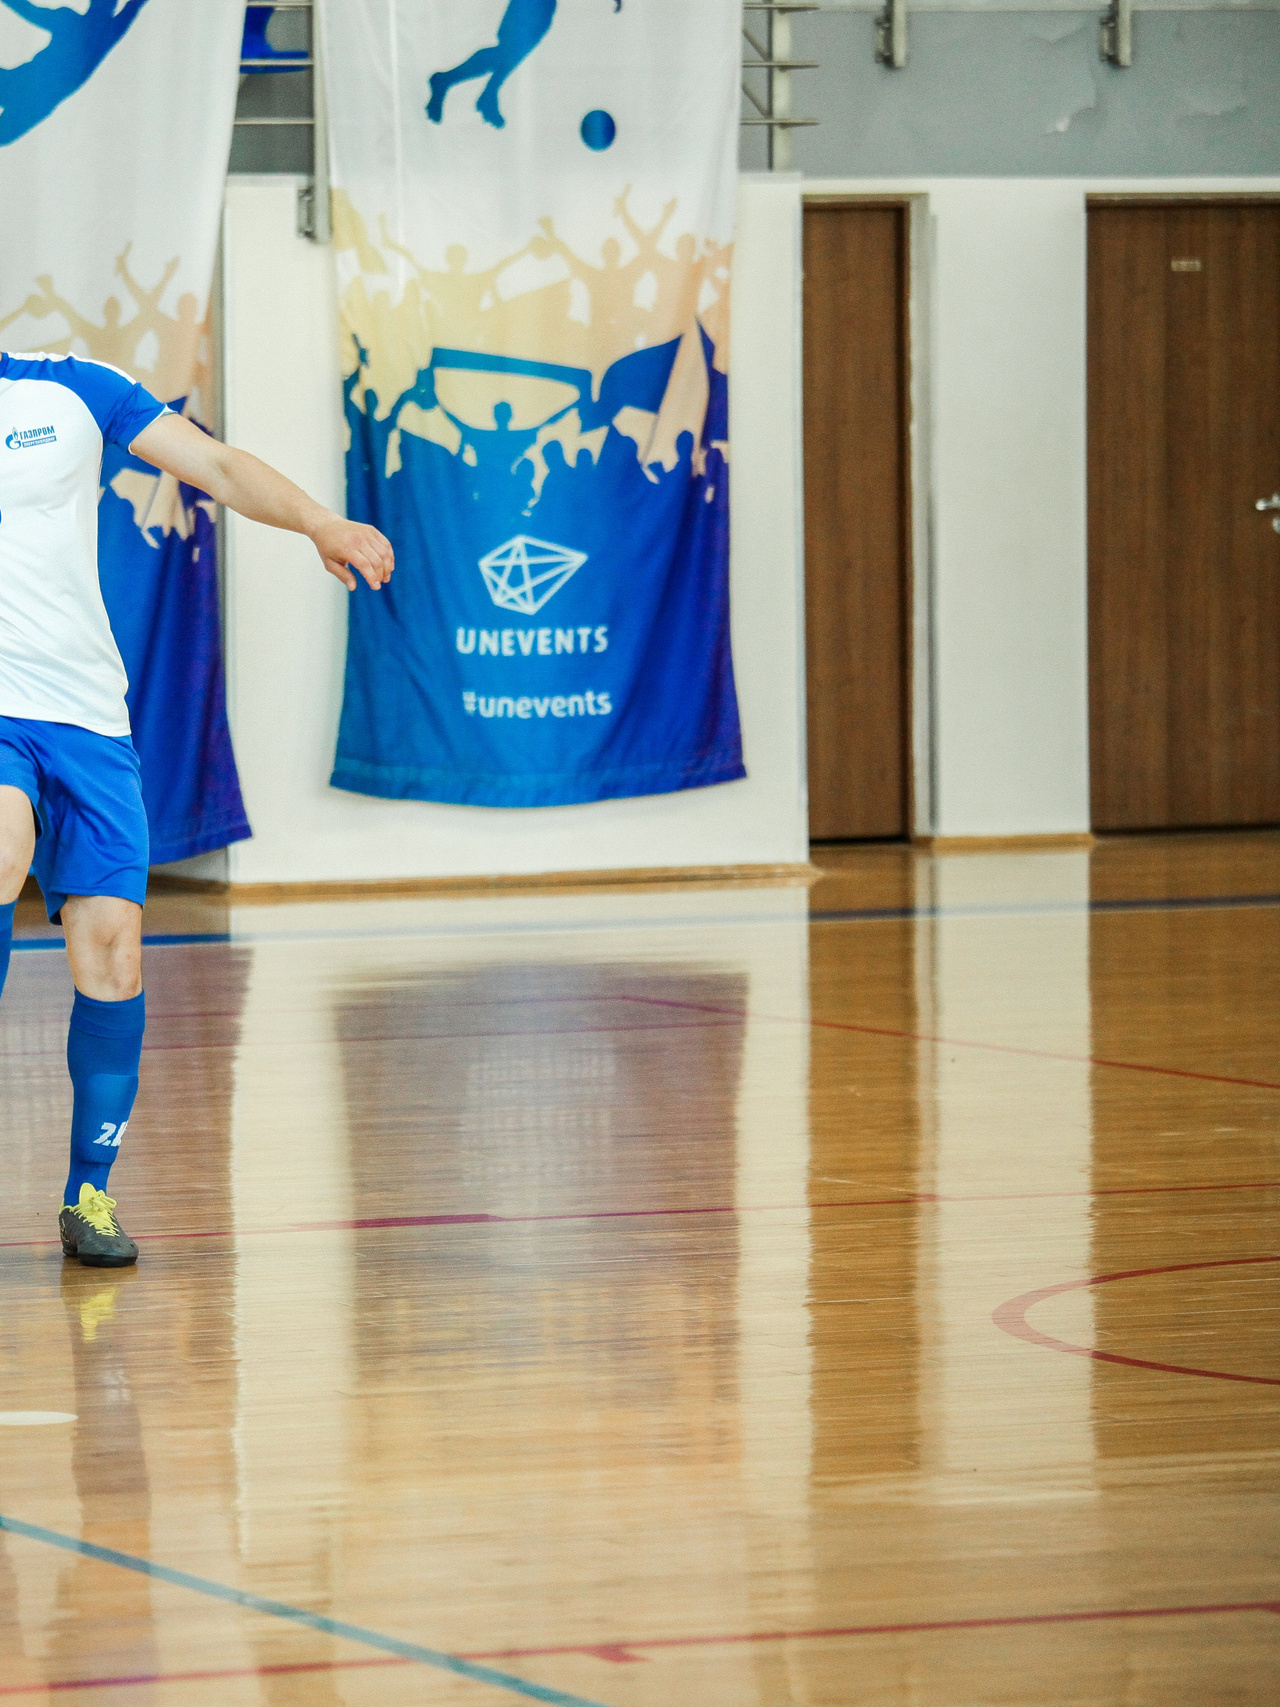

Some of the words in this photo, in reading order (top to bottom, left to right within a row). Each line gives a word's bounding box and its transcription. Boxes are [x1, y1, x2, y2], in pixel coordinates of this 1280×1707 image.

[19, 425, 55, 440] ГАЗПРОМ
[456, 626, 608, 656] UNEVENTS
[462, 688, 612, 719] #unevents
